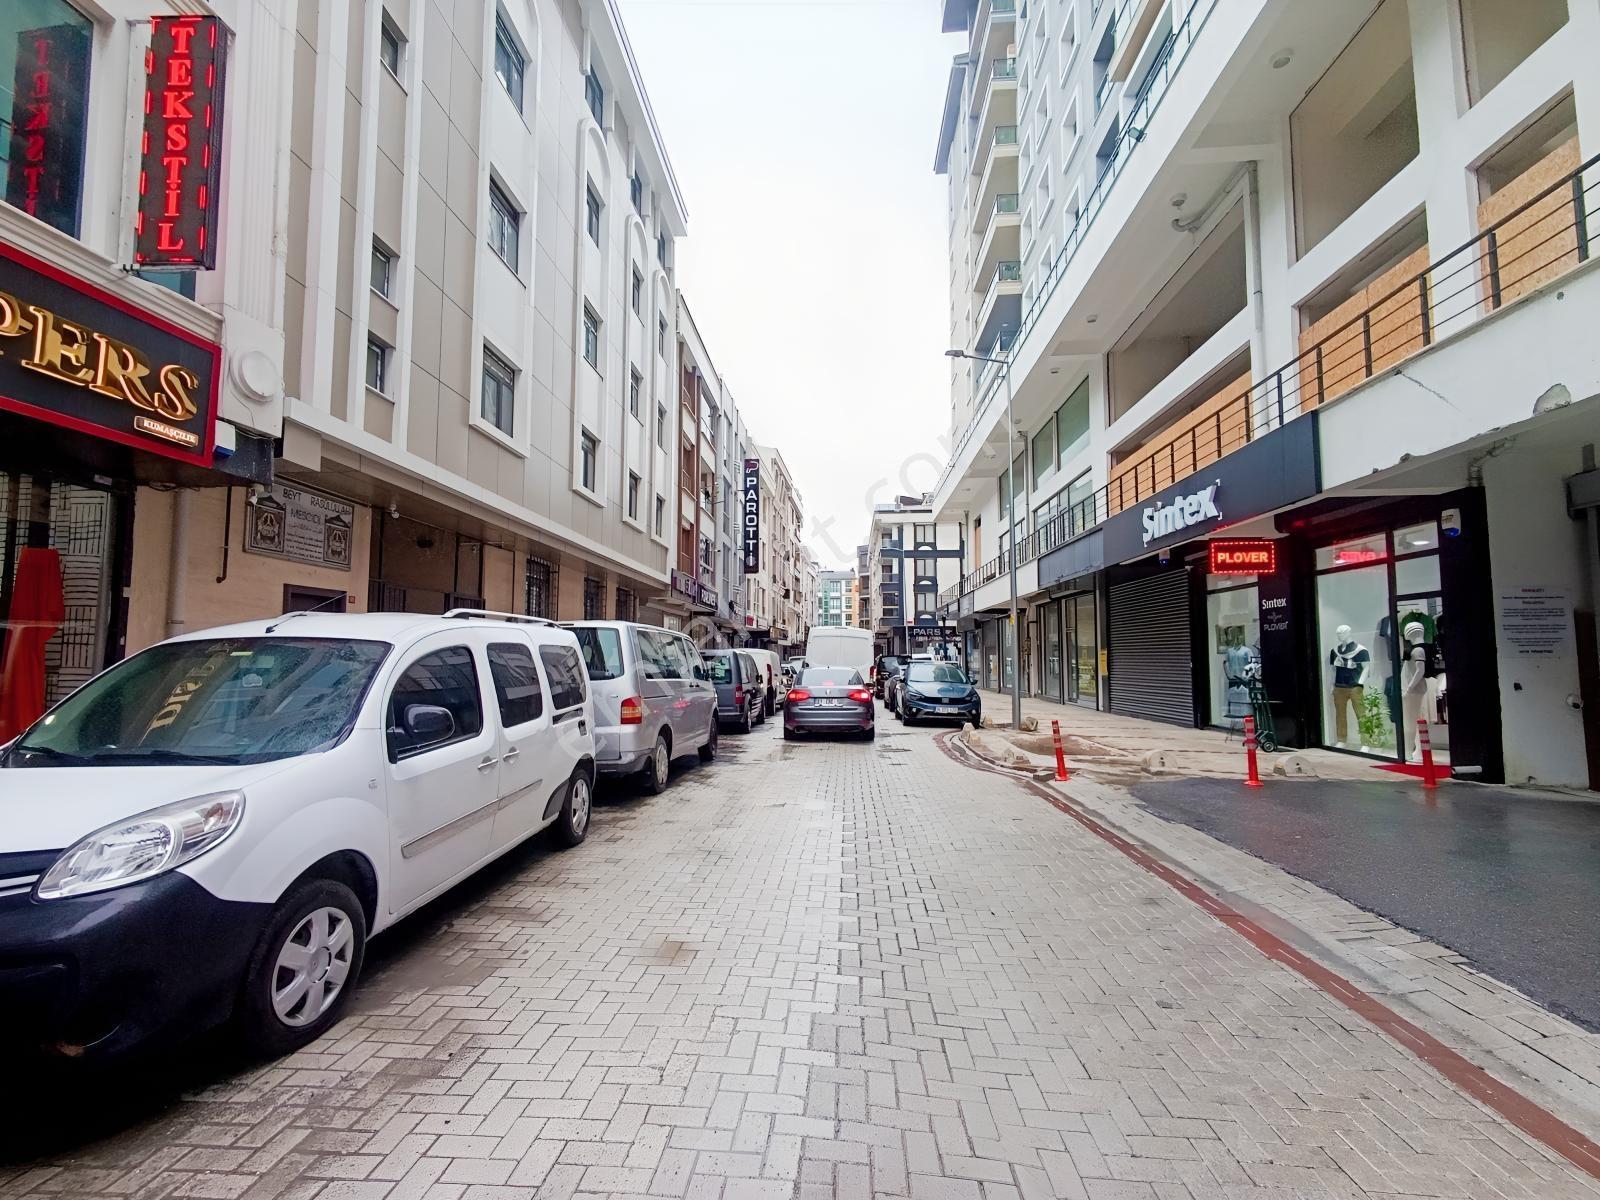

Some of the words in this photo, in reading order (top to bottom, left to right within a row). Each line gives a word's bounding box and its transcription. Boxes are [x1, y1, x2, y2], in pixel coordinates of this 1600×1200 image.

[157, 26, 195, 250] TEKSTİL
[1142, 484, 1220, 544] Sintex
[1217, 552, 1269, 563] PLOVER
